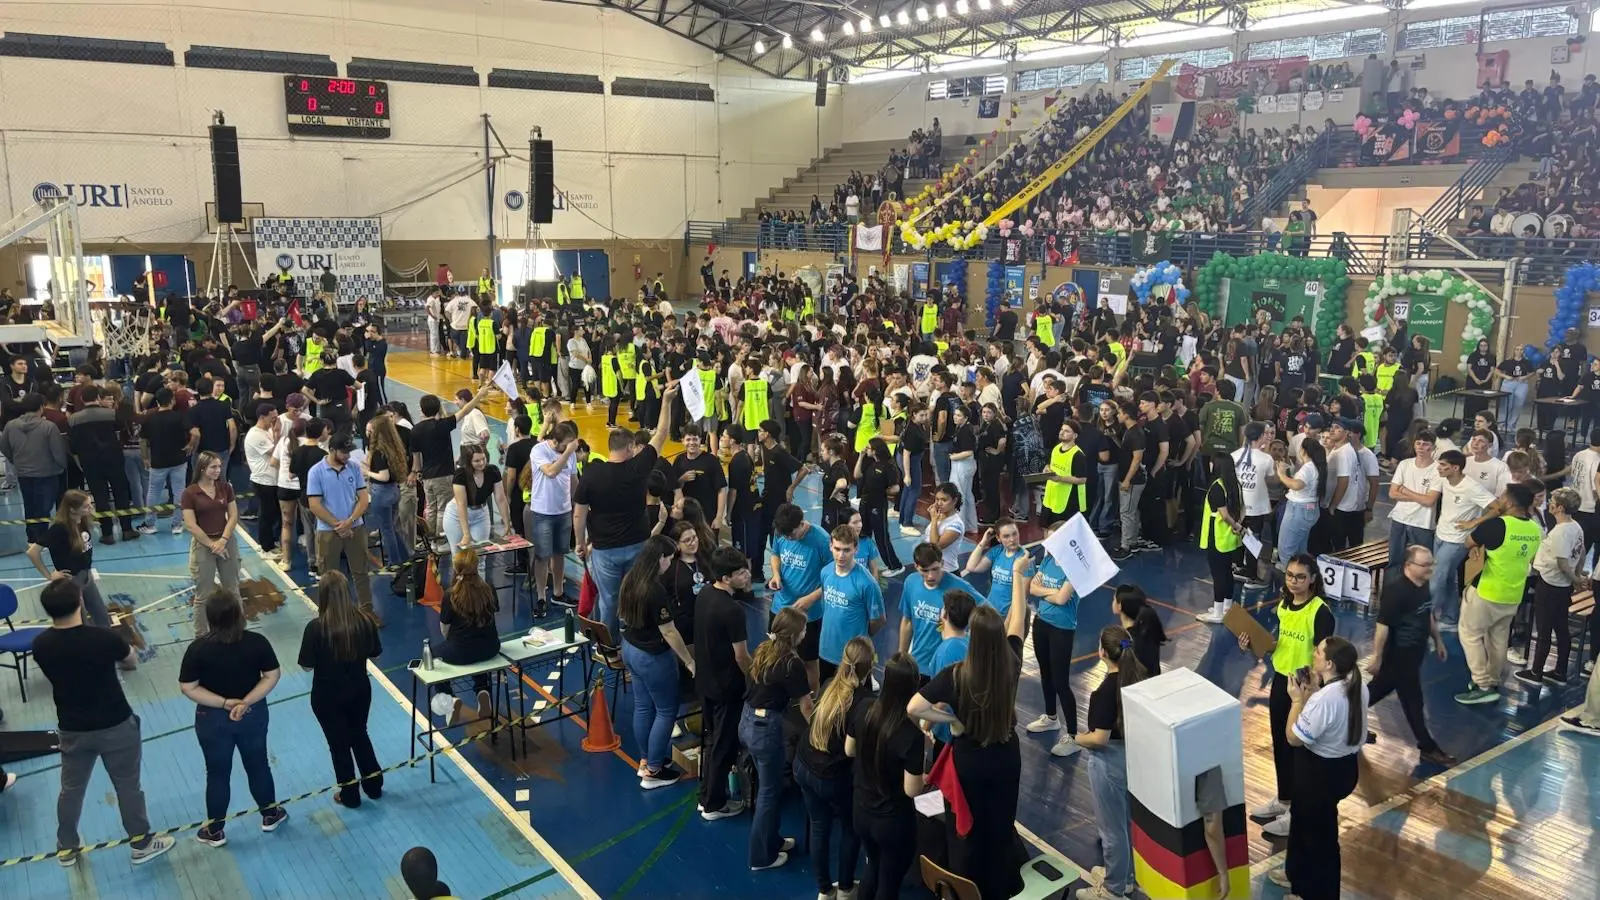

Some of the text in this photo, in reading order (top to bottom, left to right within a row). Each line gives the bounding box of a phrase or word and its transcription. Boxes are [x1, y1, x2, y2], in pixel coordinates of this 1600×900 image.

[301, 80, 309, 91] 0
[328, 80, 355, 95] 2:00
[368, 85, 376, 96] 0
[308, 97, 317, 111] 0
[375, 101, 384, 115] 0
[301, 116, 326, 124] LOCAL
[346, 118, 384, 127] VISITANTE
[64, 184, 122, 207] URI
[130, 187, 165, 196] SANTO
[132, 195, 173, 206] ÂNGELO
[296, 254, 334, 270] URI
[1306, 282, 1318, 292] 40
[1394, 305, 1408, 316] 37
[1074, 545, 1085, 561] URI
[1324, 567, 1360, 591] 3 1
